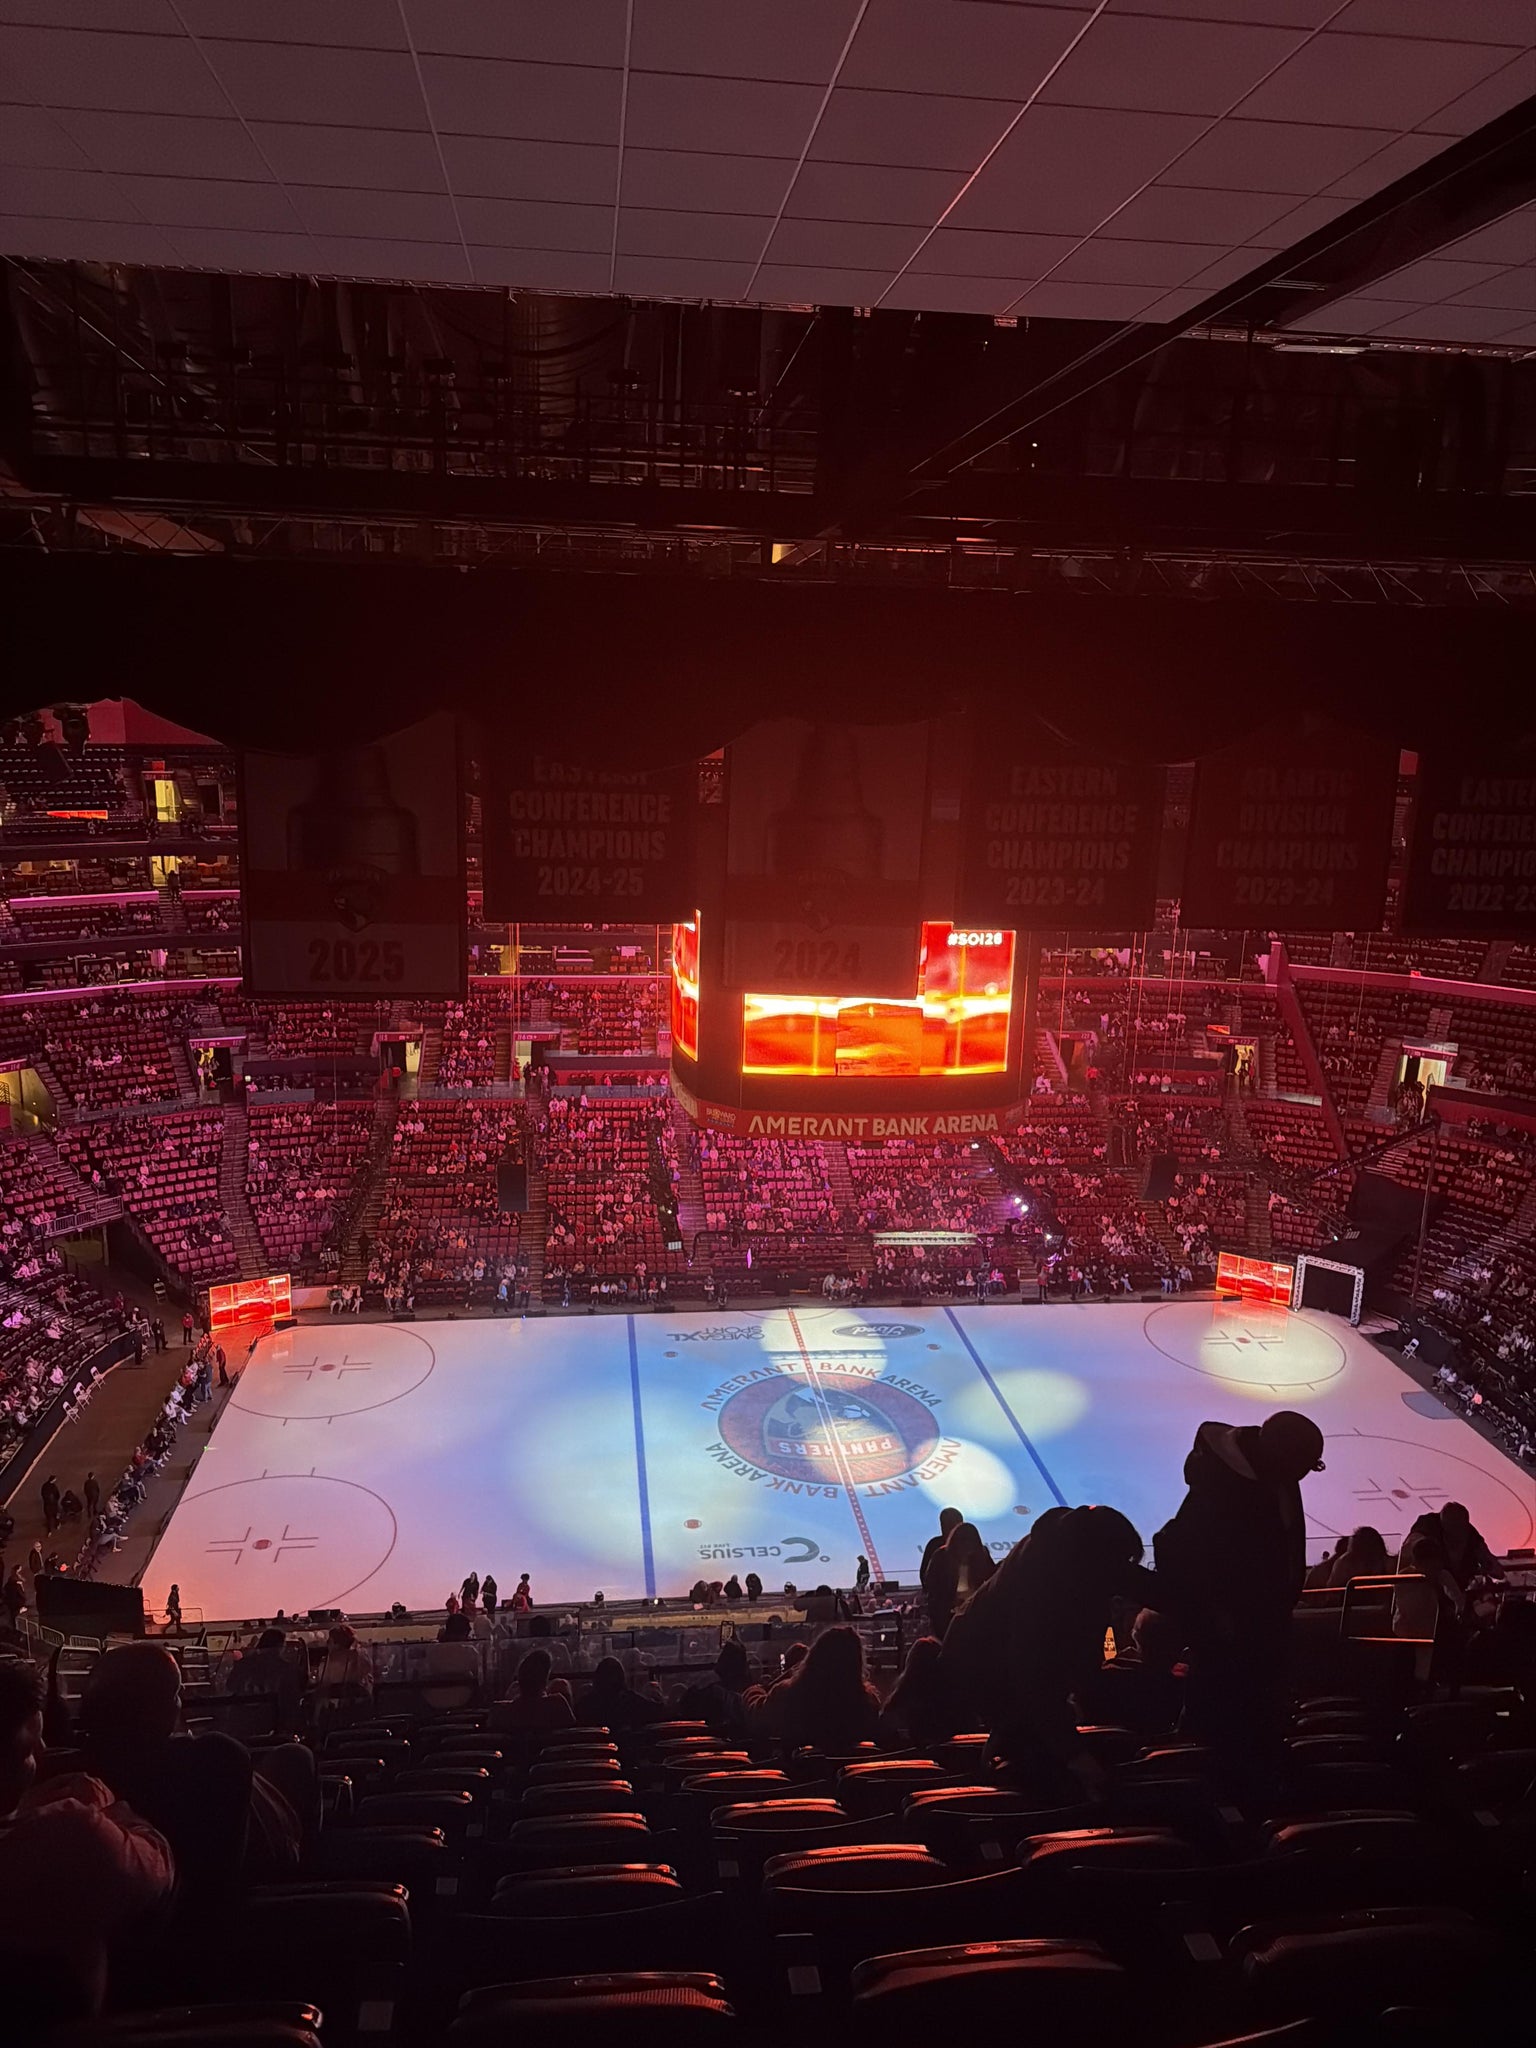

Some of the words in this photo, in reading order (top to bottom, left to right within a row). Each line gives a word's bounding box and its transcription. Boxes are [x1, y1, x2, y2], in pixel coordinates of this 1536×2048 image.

[510, 790, 671, 823] CONFERENCE
[985, 803, 1138, 833] CONFERENCE
[1240, 804, 1347, 834] DIVISION
[1432, 812, 1536, 842] CONFERE
[513, 828, 666, 861] CHAMPIONS
[987, 839, 1130, 870] CHAMPIONS
[1216, 840, 1359, 871] CHAMPIONS
[537, 865, 644, 896] 2024-25
[1005, 877, 1105, 906] 2023-24
[1233, 876, 1334, 907] 2023-24
[307, 939, 405, 982] 2025
[774, 938, 860, 979] 2024
[749, 1115, 868, 1137] AMERANT
[872, 1116, 930, 1136] BANK
[932, 1114, 999, 1135] ARENA
[704, 1325, 763, 1334] SPORT
[852, 1325, 906, 1337] Ford
[700, 1362, 798, 1411] AMERANT
[820, 1362, 883, 1378] BANK
[881, 1374, 943, 1408] ARENA
[705, 1441, 769, 1482] ARENA
[779, 1437, 892, 1455] PANTHERS
[864, 1437, 962, 1498] AMERANT
[765, 1476, 839, 1499] BANK
[699, 1546, 782, 1560] CELSIUS
